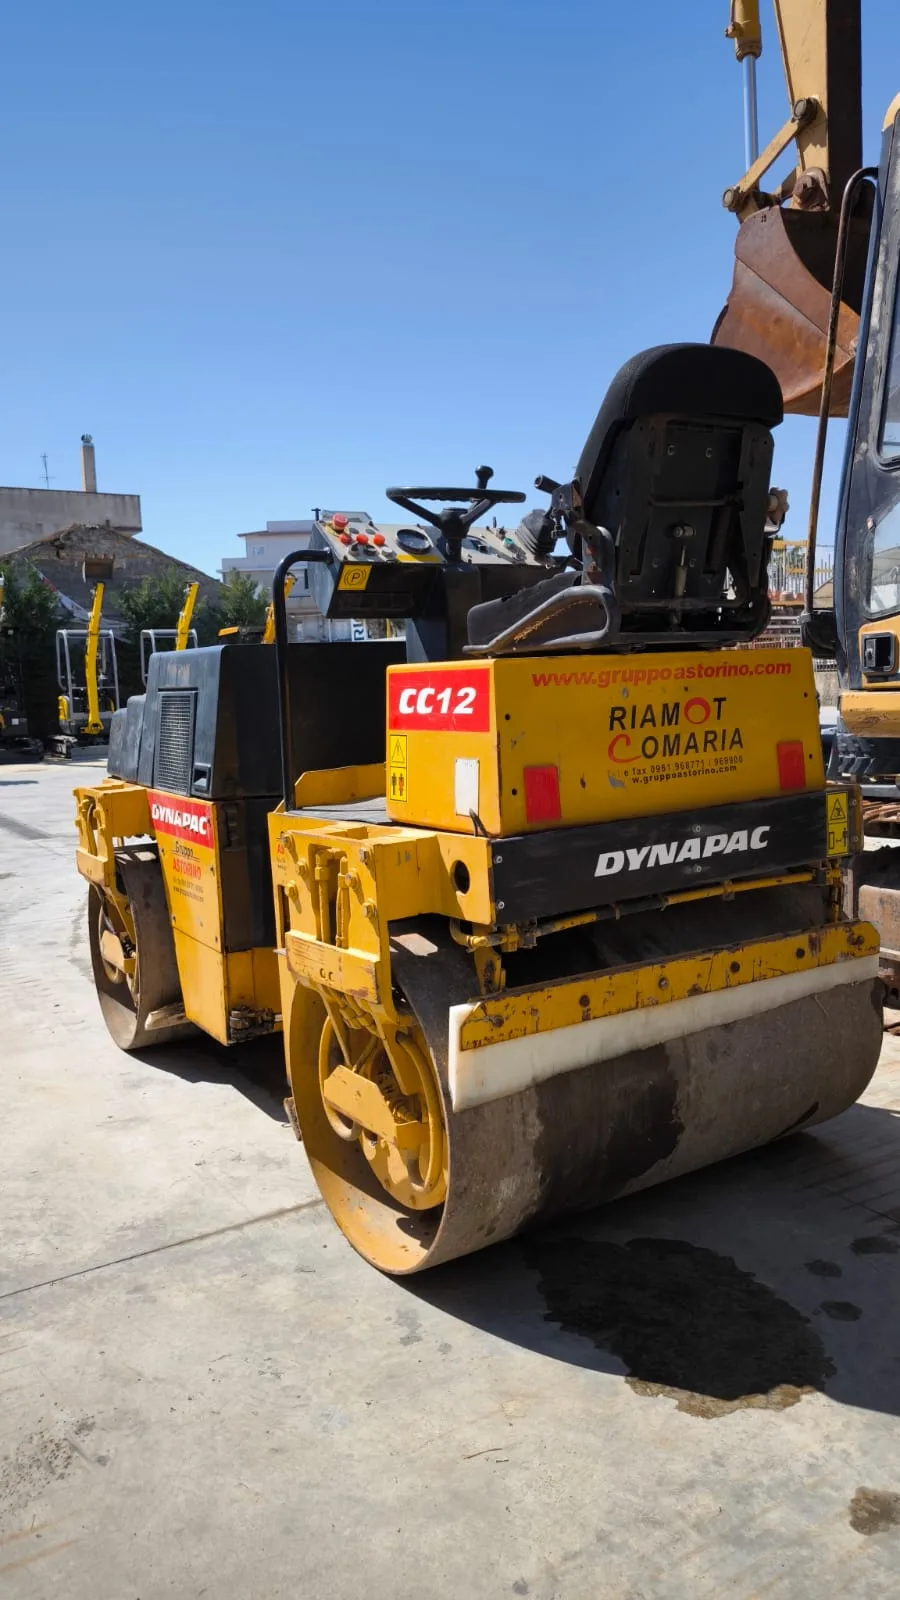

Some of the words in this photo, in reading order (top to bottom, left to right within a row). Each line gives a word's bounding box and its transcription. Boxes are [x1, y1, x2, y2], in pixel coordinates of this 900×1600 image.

[531, 661, 792, 688] www.gruppoastorino.com
[399, 687, 477, 715] CC12
[608, 697, 727, 731] RIAMOT
[607, 727, 744, 764] COMARIA
[632, 767, 647, 776] fax
[151, 803, 209, 836] DYNAPAC
[594, 825, 771, 878] DYNAPAC
